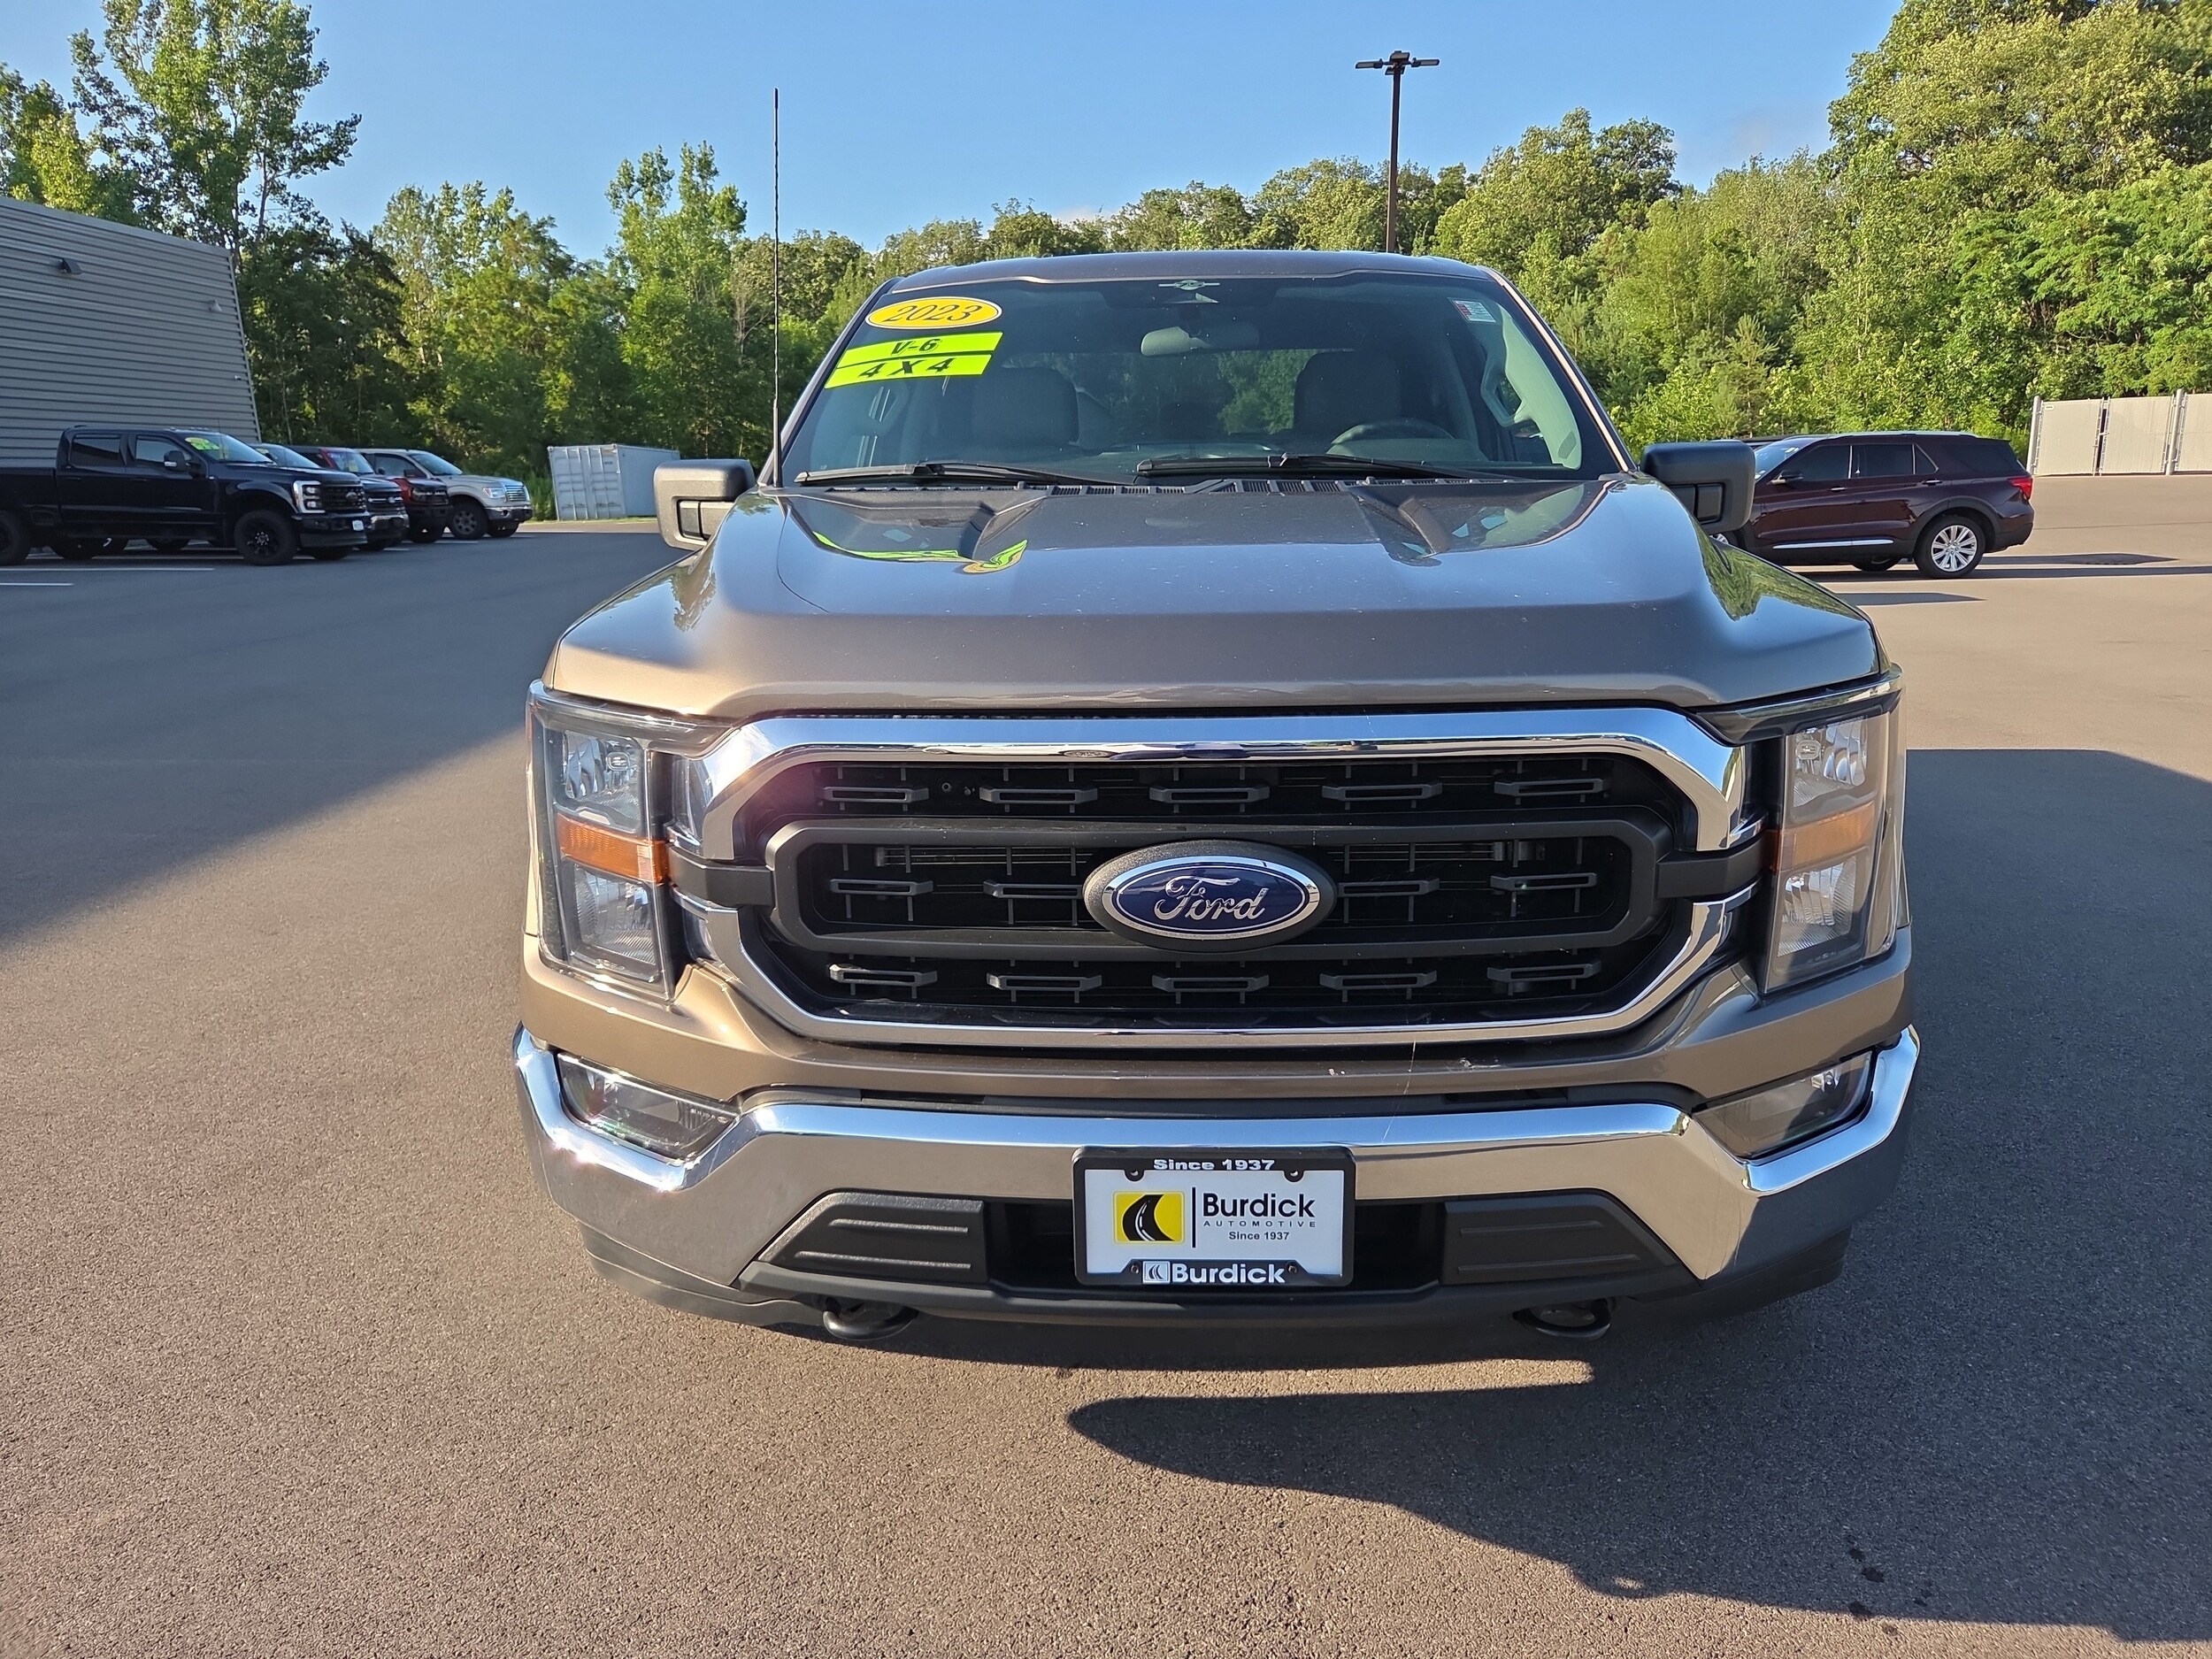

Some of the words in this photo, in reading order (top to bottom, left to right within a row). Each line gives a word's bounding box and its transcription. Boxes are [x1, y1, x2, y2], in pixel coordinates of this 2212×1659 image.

[881, 304, 982, 323] 2023
[891, 338, 941, 355] V-6
[858, 357, 956, 378] 4X4
[1154, 875, 1269, 920] Ford
[1153, 1158, 1215, 1171] Since
[1222, 1158, 1275, 1171] 1937
[1202, 1192, 1316, 1217] Burdick
[1228, 1231, 1260, 1240] Since
[1263, 1231, 1290, 1240] 1937
[1171, 1263, 1286, 1284] Burdick
